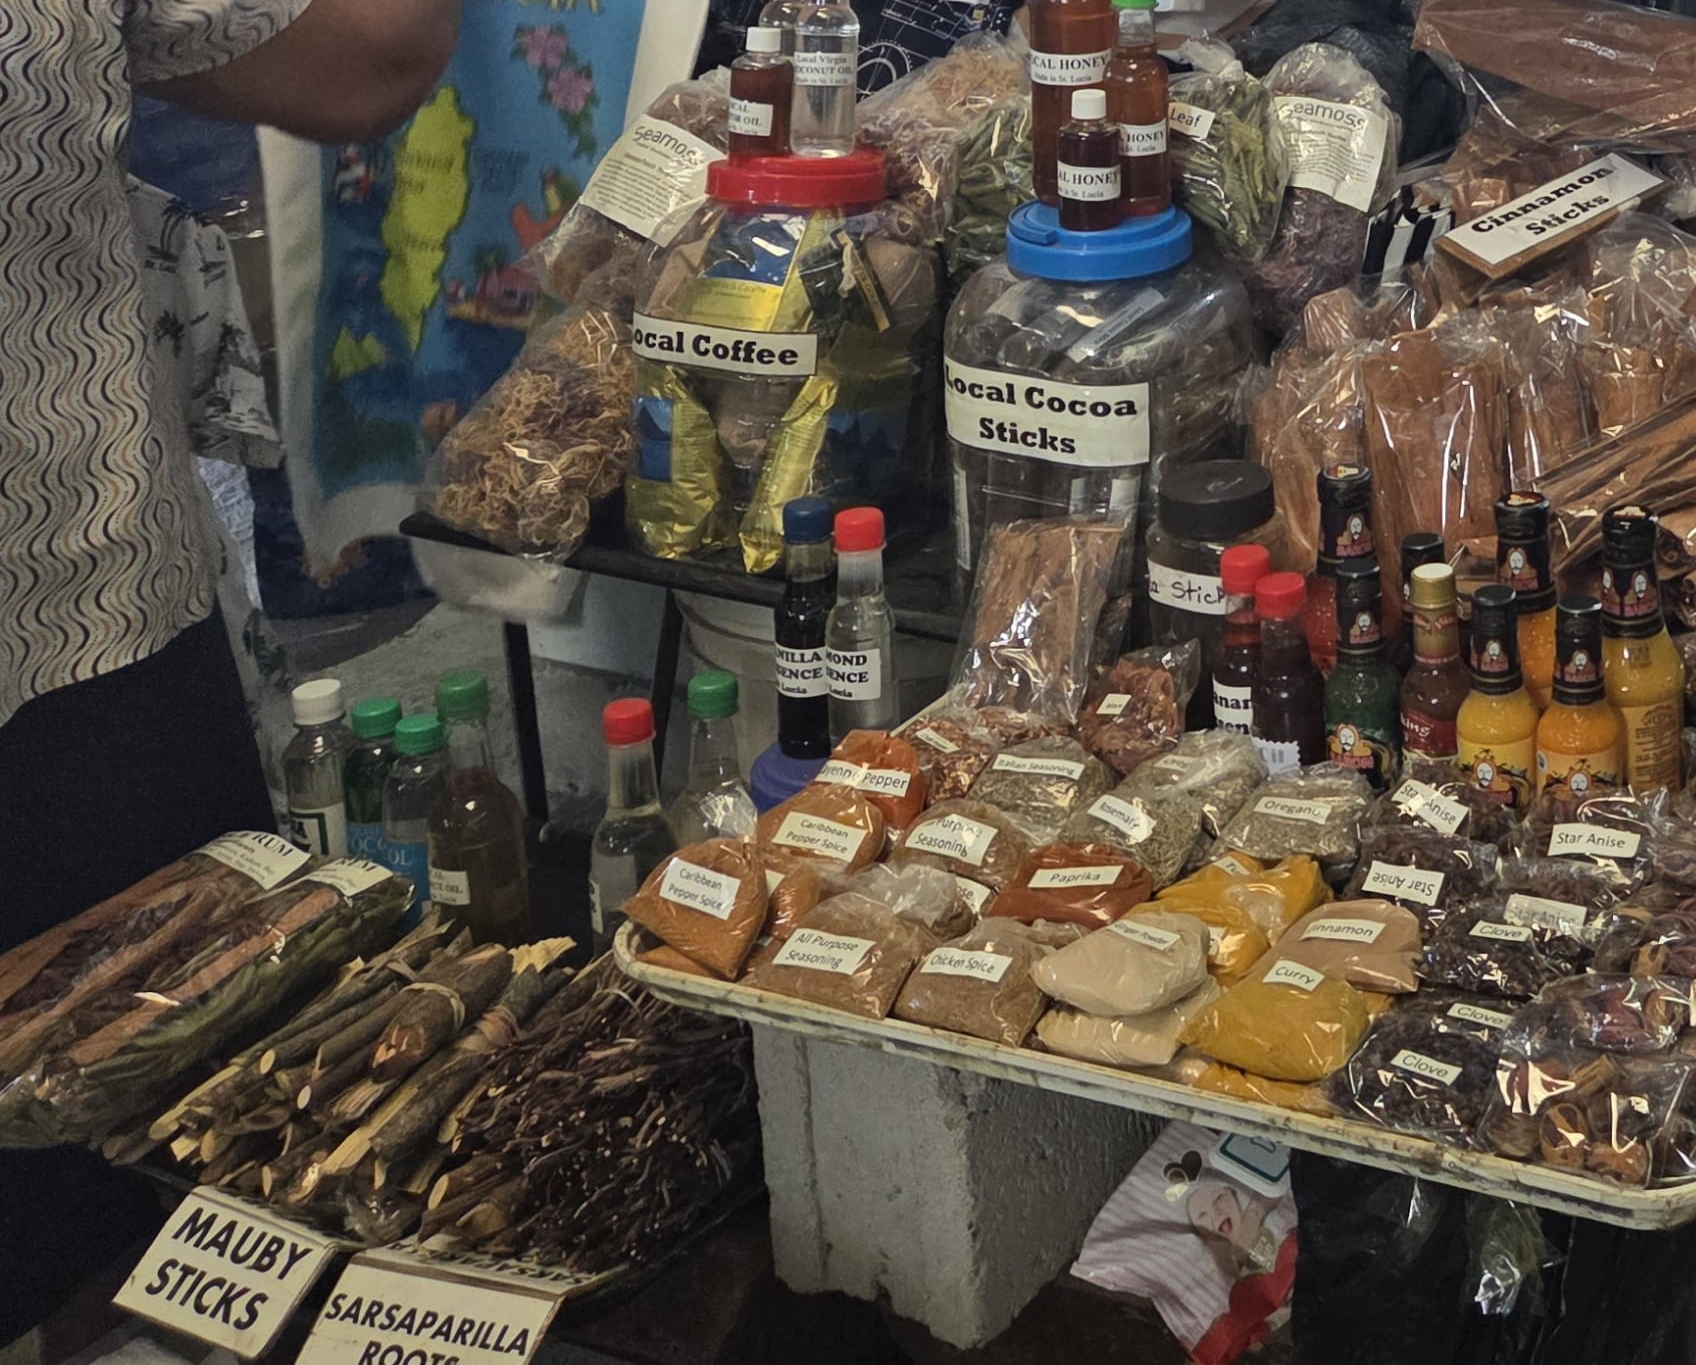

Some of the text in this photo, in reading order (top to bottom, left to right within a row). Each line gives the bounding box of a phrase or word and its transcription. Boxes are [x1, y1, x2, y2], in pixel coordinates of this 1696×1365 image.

[795, 65, 837, 76] CONUT
[1032, 53, 1107, 70] CAL HONEY
[1170, 107, 1203, 129] Leaf
[1126, 130, 1165, 144] HONEY
[1072, 168, 1119, 186] HONEY
[1471, 166, 1615, 234] Cinnamon
[1525, 193, 1610, 236] Sticks
[633, 328, 799, 366] ocal Coffee
[944, 362, 1138, 418] Local Cocoa
[979, 417, 1077, 455] Sticks
[776, 651, 823, 664] NILLA
[1027, 760, 1076, 776] Seasoning
[862, 771, 908, 791] Pepper
[1400, 783, 1424, 801] Sta
[1424, 799, 1457, 826] Anise
[800, 818, 849, 840] Caribbean
[1556, 831, 1627, 849] Star Anise
[785, 830, 848, 855] Pepper Spice
[916, 833, 969, 858] Seasoning
[678, 867, 722, 890] Caribbean
[1049, 871, 1102, 884] Paprika
[1371, 870, 1436, 896] Star Anise
[667, 883, 723, 912] Pepper Spice
[1479, 924, 1523, 939] Clove
[796, 933, 860, 953] All Purpose
[785, 950, 843, 970] Seasoning
[929, 953, 996, 976] Chicken Spice
[1275, 966, 1316, 985] Curry
[1457, 1006, 1504, 1026] Clove
[1402, 1053, 1449, 1079] Clove
[171, 1206, 314, 1281] MAUBY
[145, 1257, 269, 1332] STICKS
[325, 1292, 530, 1357] SARSAPARILLA
